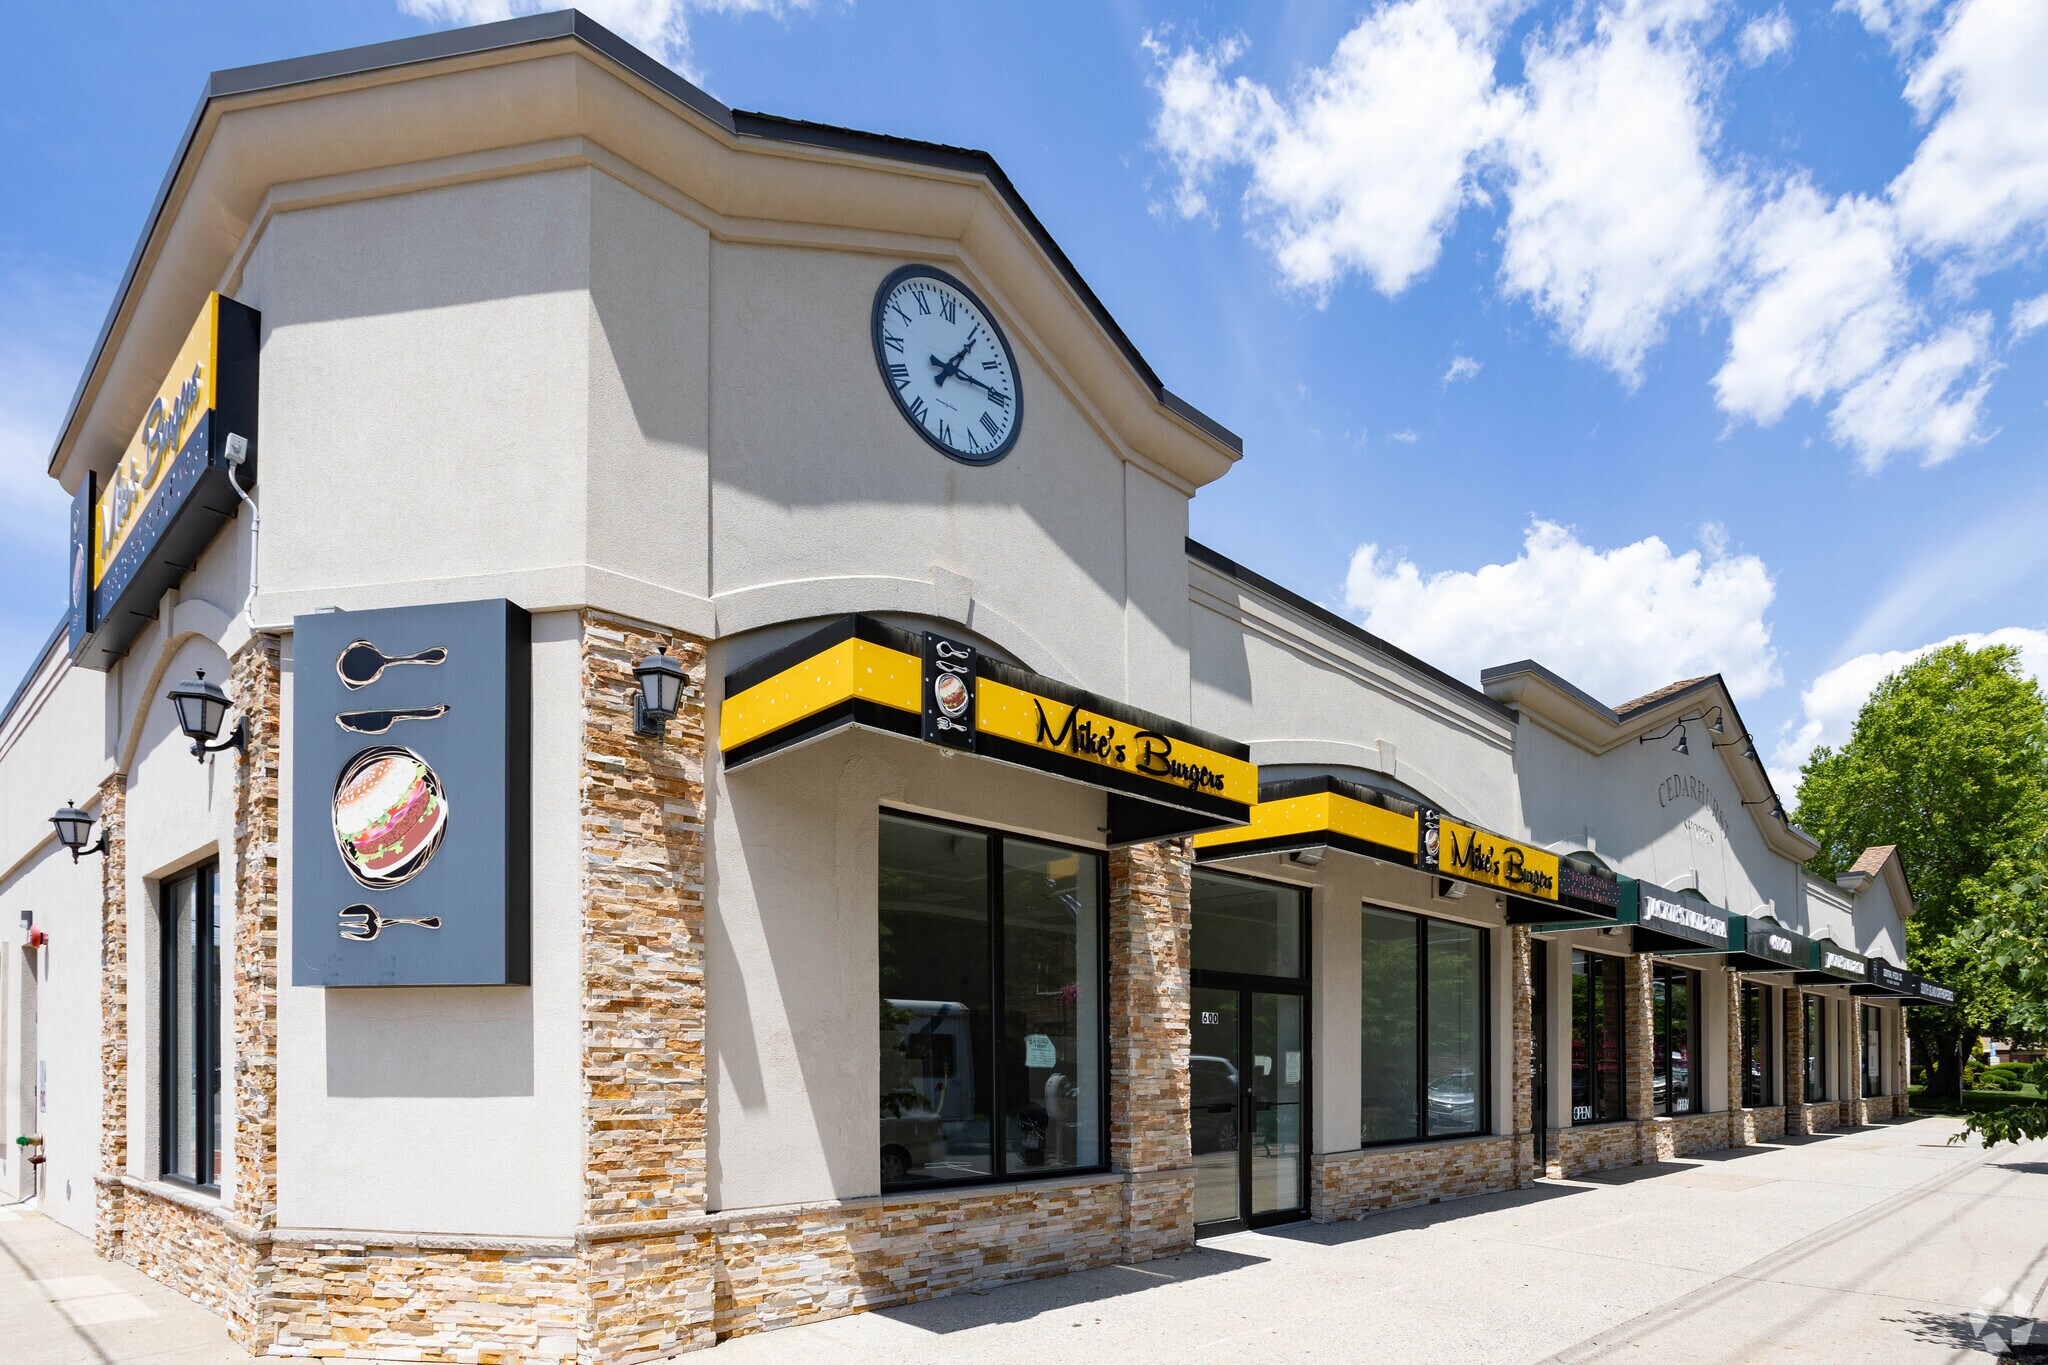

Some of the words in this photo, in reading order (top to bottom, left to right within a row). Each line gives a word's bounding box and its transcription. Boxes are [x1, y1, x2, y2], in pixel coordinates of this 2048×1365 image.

[939, 296, 956, 325] XII
[1033, 698, 1126, 763] Mike's
[1134, 731, 1225, 792] Burgers
[1658, 774, 1731, 840] CEDARHURST
[1450, 830, 1500, 876] Mike's
[1502, 846, 1553, 893] Burgers
[1202, 1012, 1218, 1023] 600
[1573, 1106, 1592, 1120] OPEN
